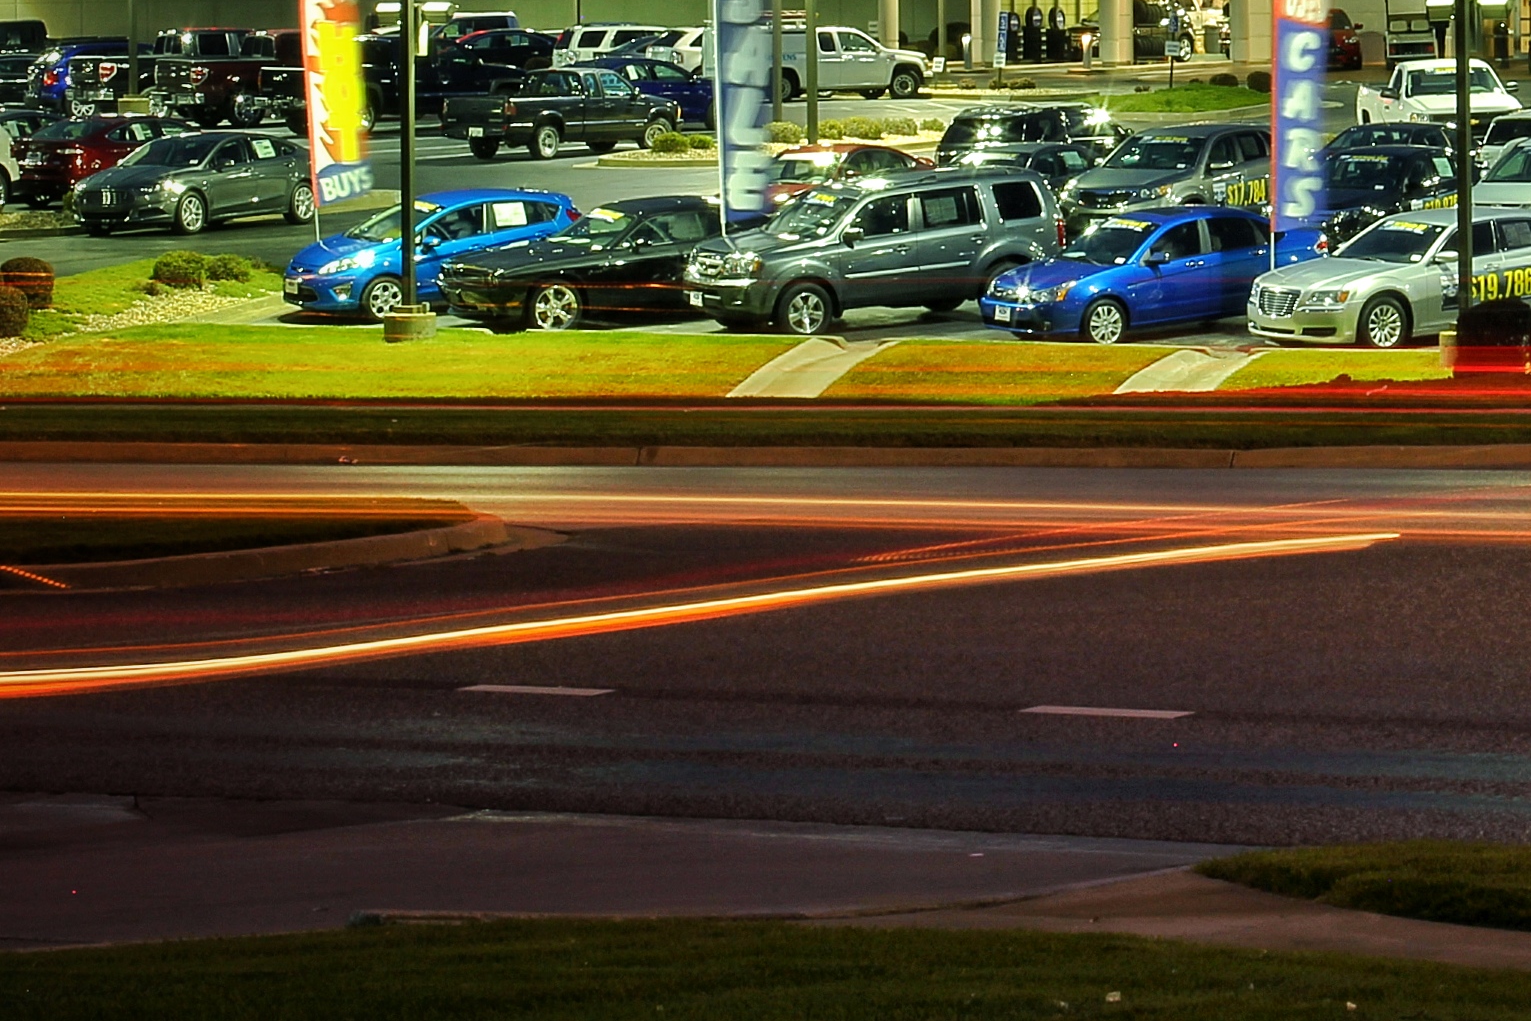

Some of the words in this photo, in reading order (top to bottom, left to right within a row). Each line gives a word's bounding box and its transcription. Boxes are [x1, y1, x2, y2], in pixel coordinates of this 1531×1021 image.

[318, 21, 368, 165] HOT
[1281, 31, 1323, 218] CARS
[319, 167, 375, 202] BUYS
